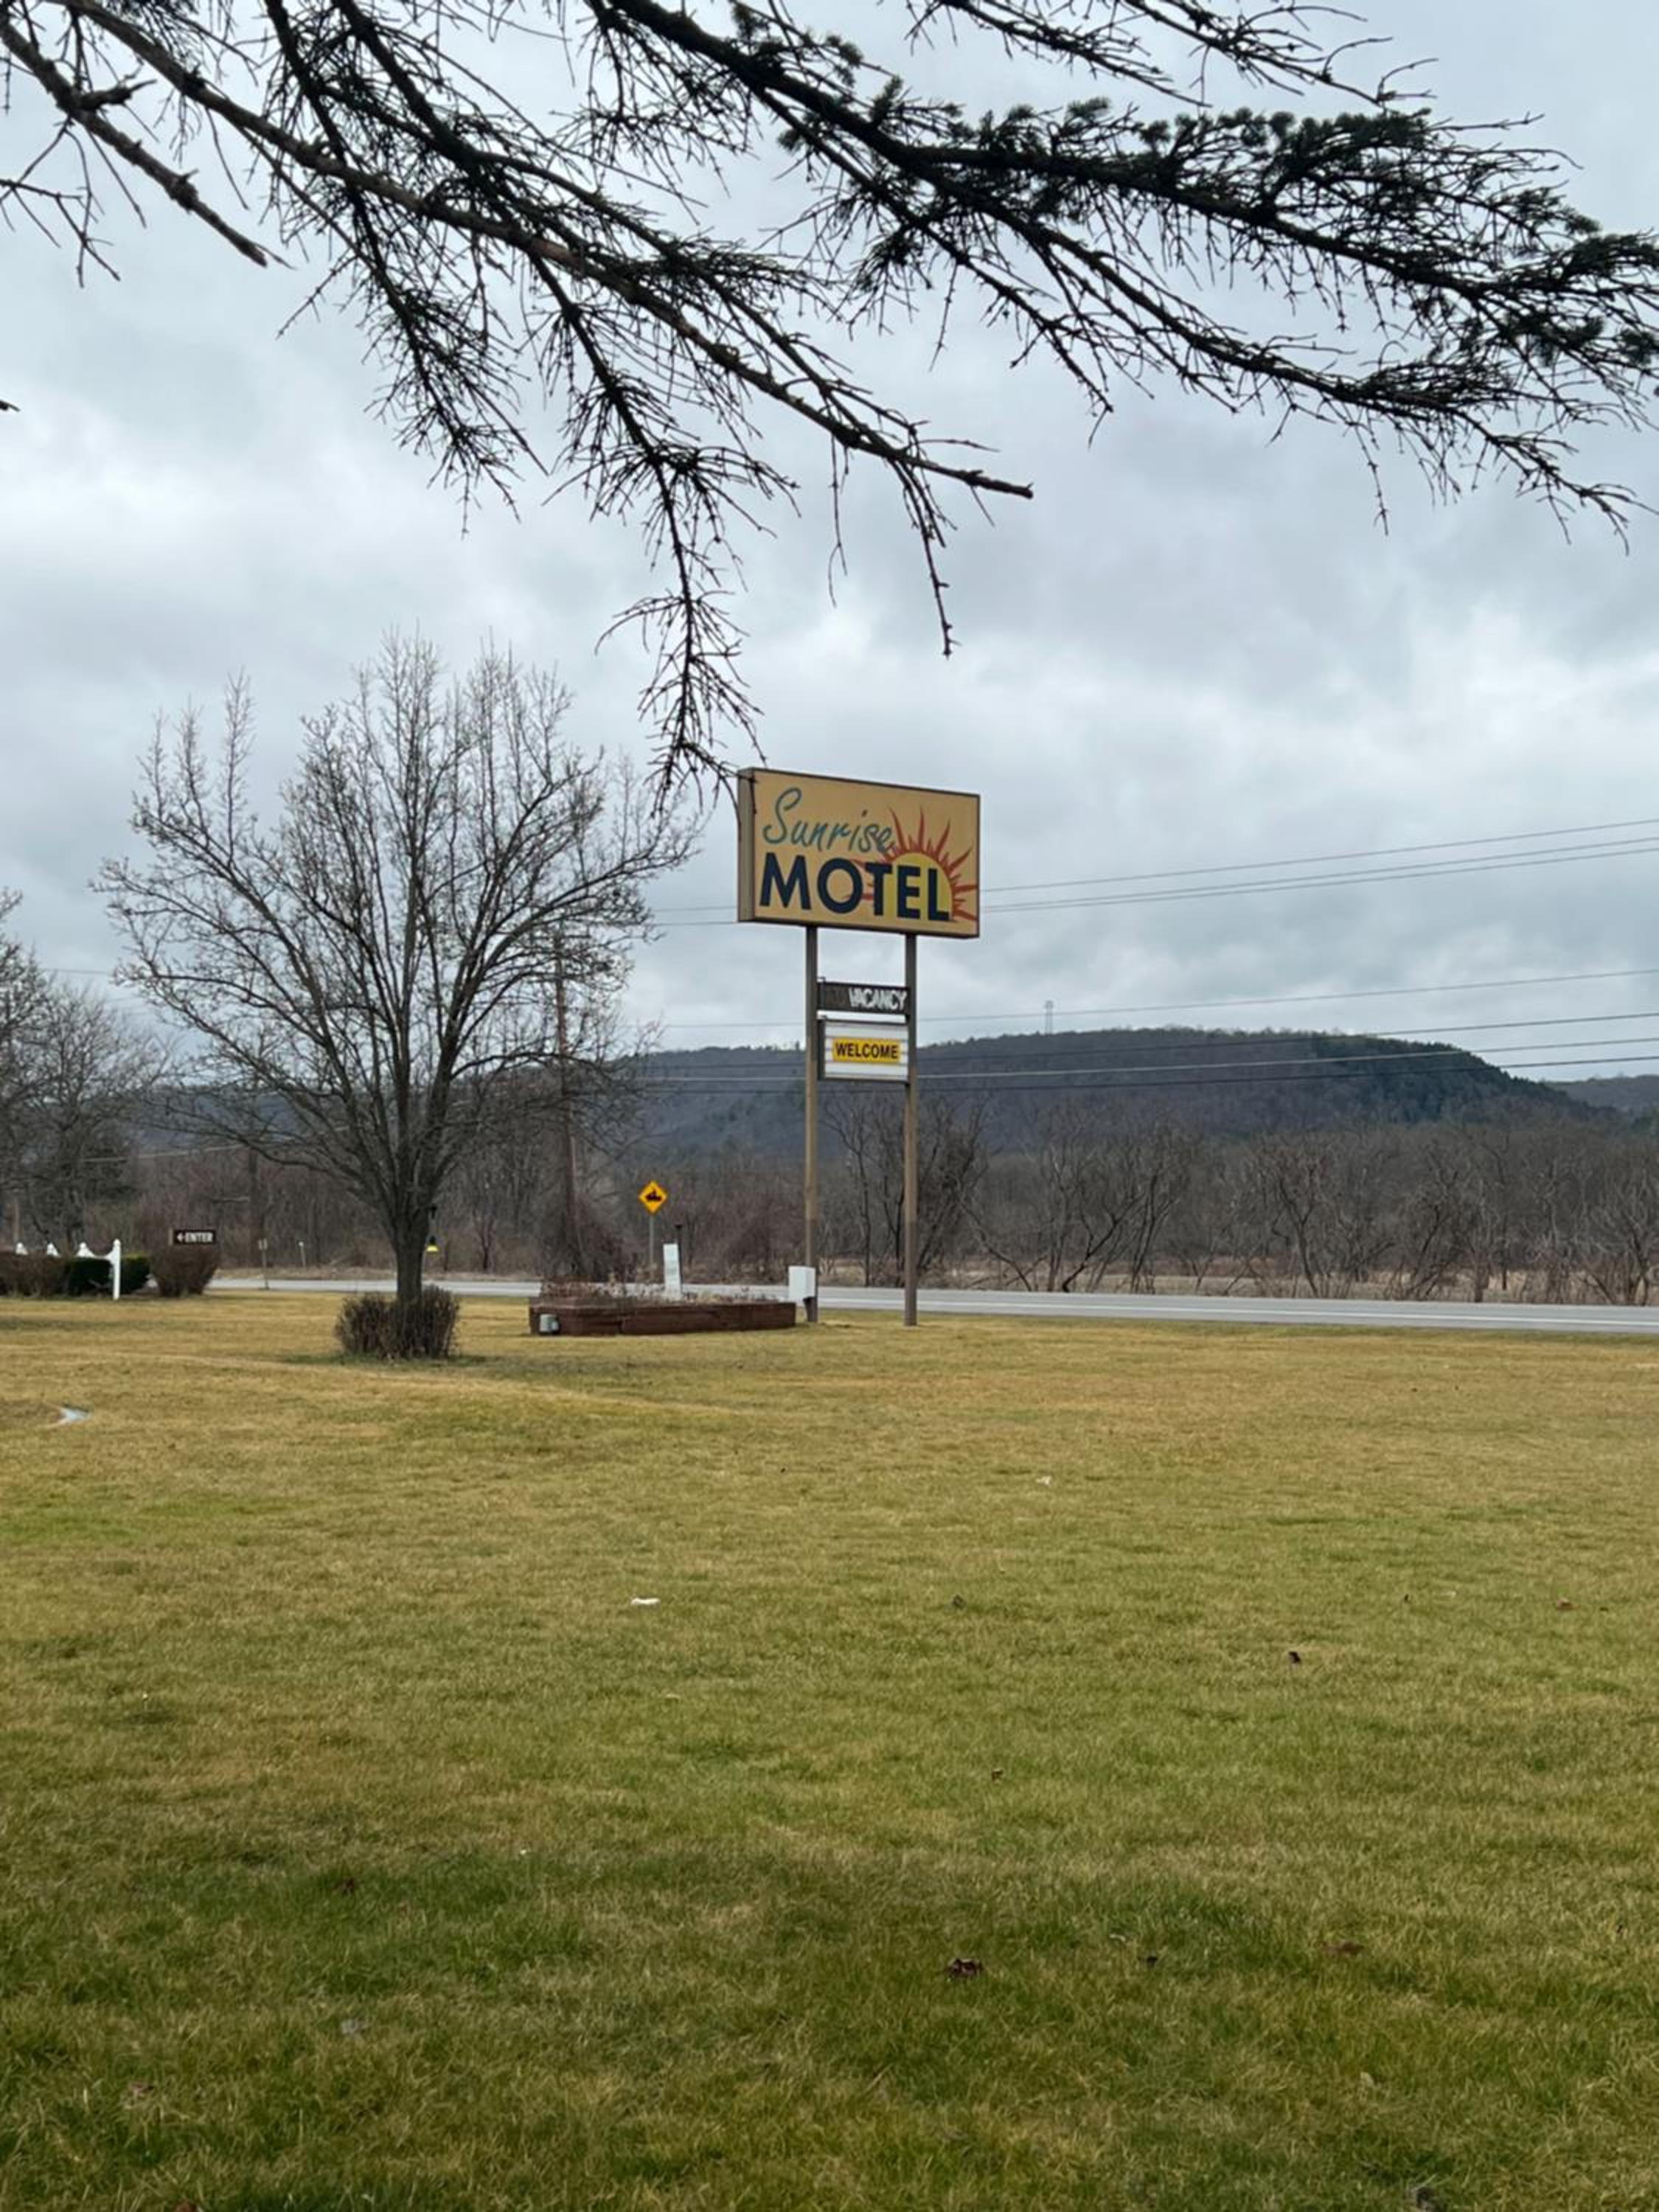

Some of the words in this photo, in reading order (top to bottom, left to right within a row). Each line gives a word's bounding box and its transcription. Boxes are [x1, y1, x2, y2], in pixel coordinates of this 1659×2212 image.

[762, 787, 894, 853] Sunrise
[759, 852, 949, 921] MOTEL
[849, 988, 907, 1010] VACANCY
[835, 1043, 899, 1059] WELCOME
